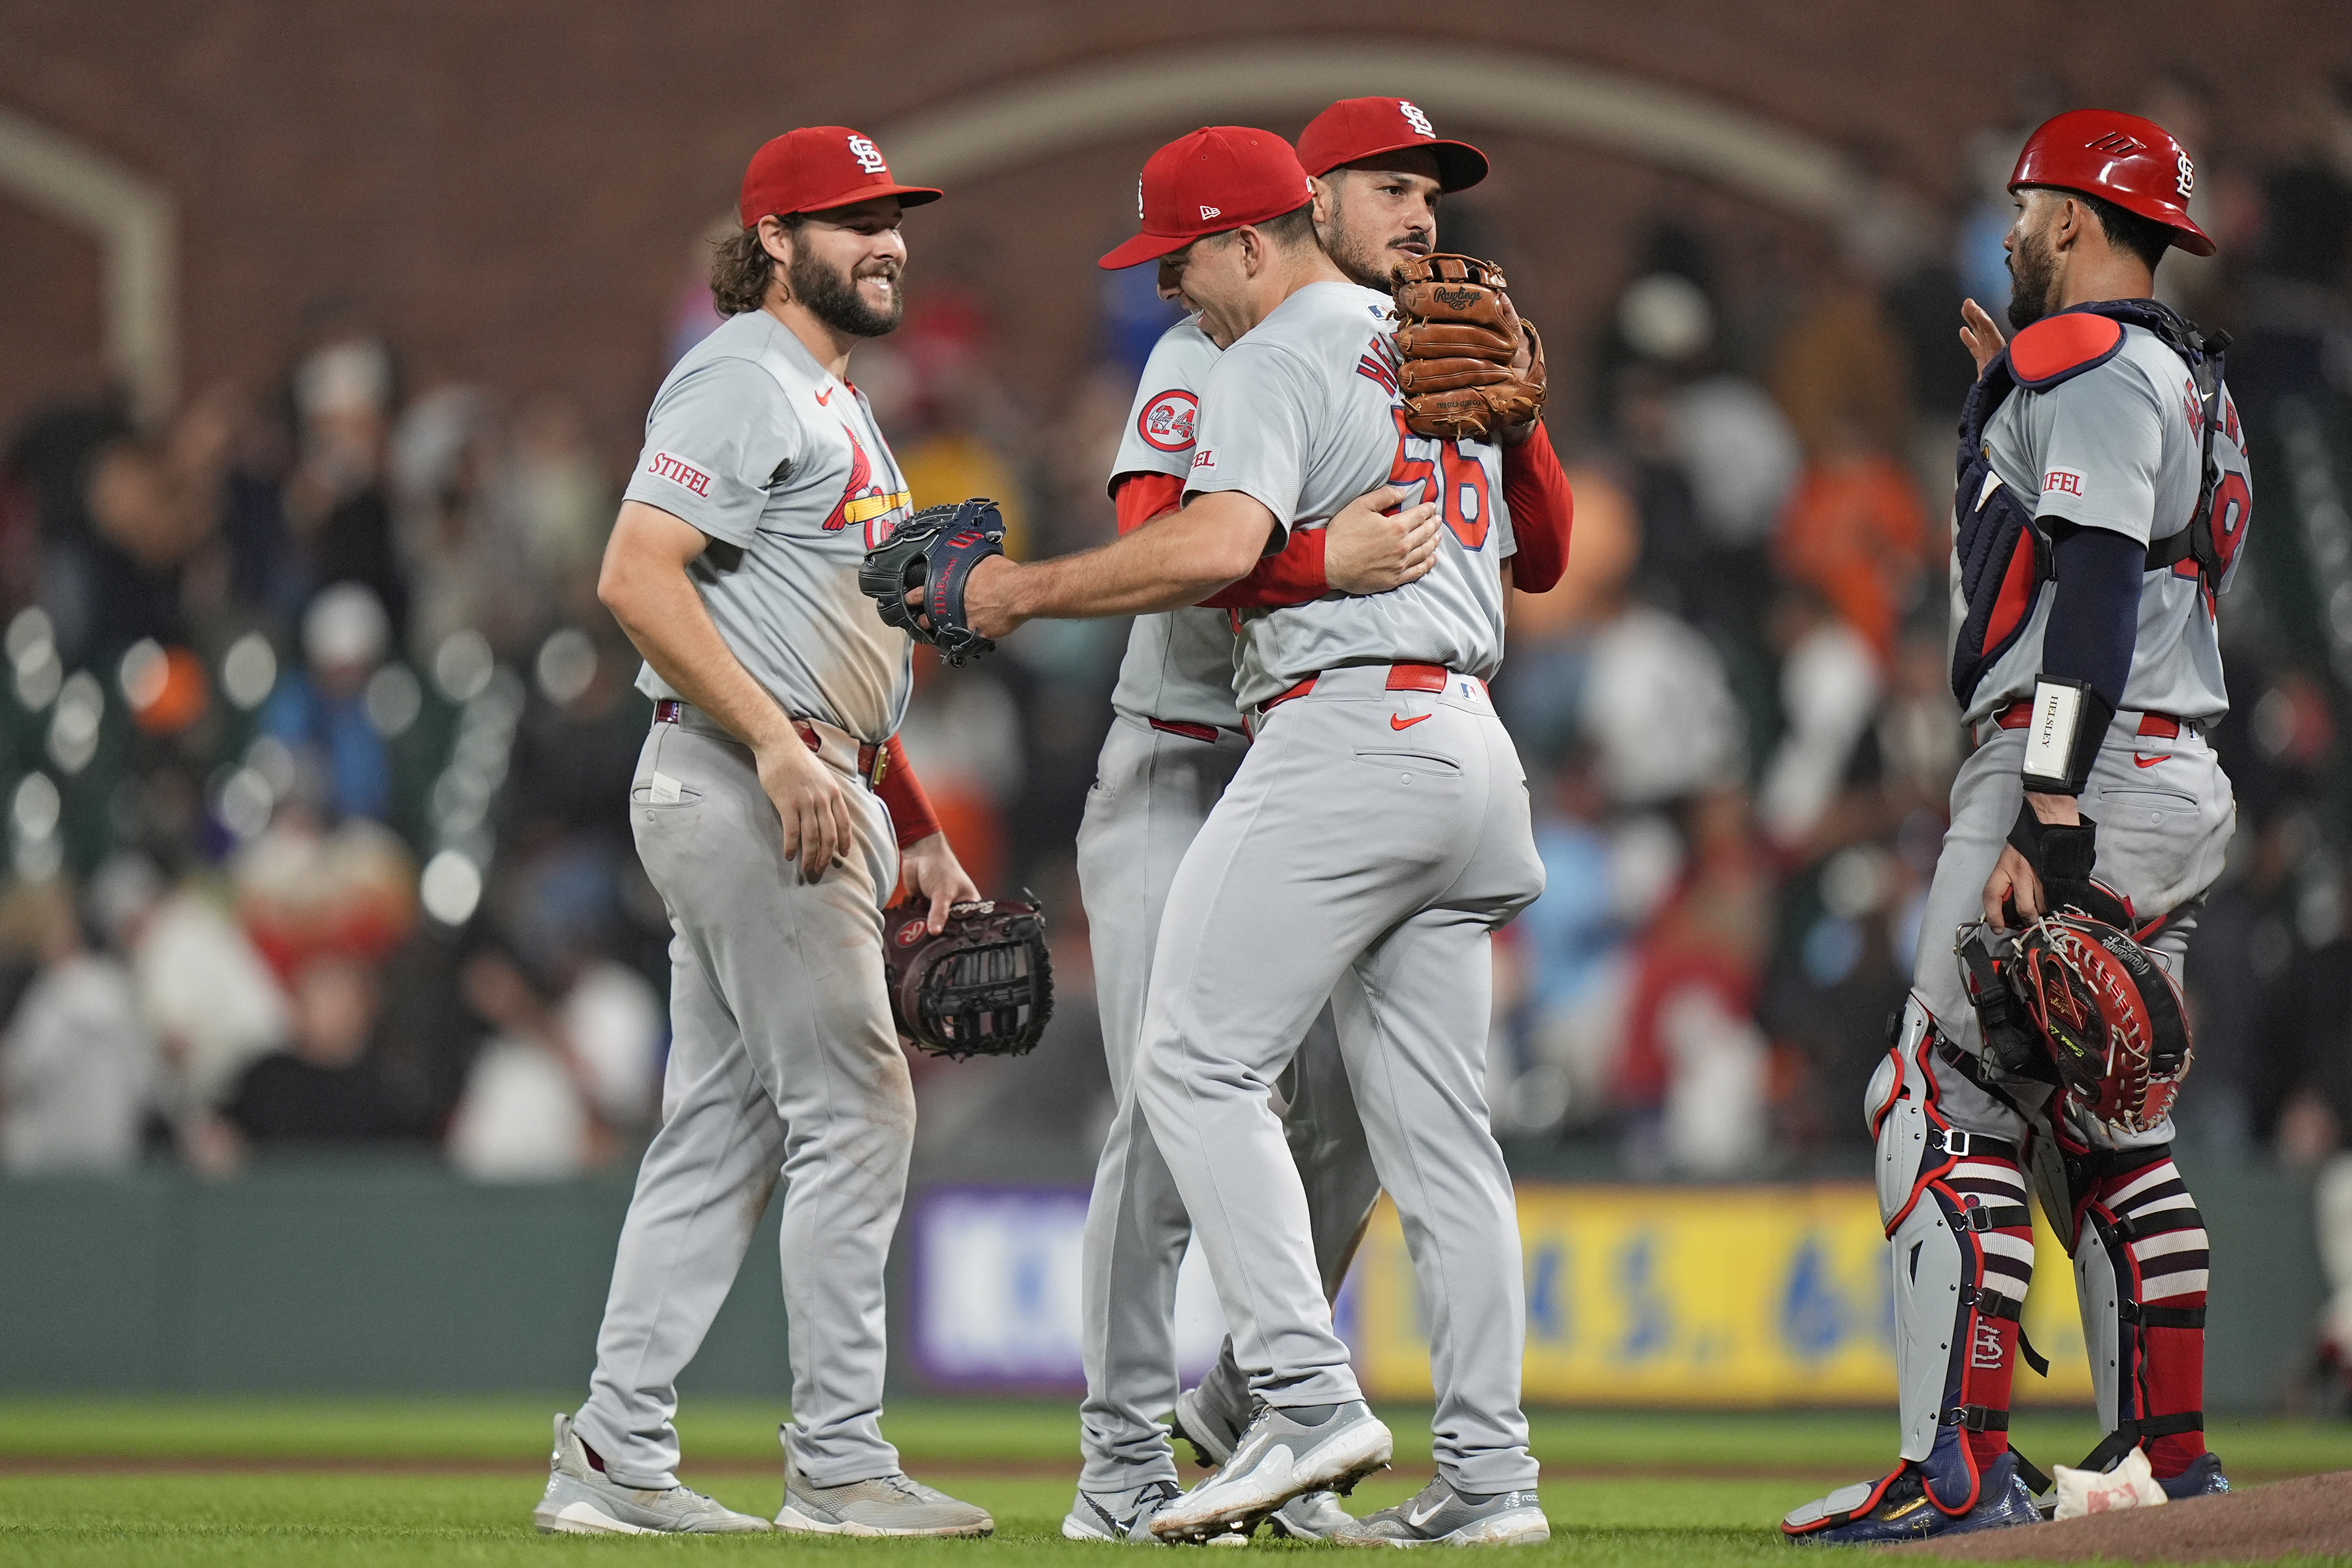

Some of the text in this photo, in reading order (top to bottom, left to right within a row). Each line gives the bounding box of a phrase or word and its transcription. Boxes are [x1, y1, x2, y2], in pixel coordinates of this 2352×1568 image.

[1434, 286, 1482, 306] Rawlings
[648, 453, 711, 498] STIFEL
[934, 557, 958, 615] Wilson
[2042, 696, 2059, 748] HELSLEY
[2101, 936, 2150, 975] Rawlings
